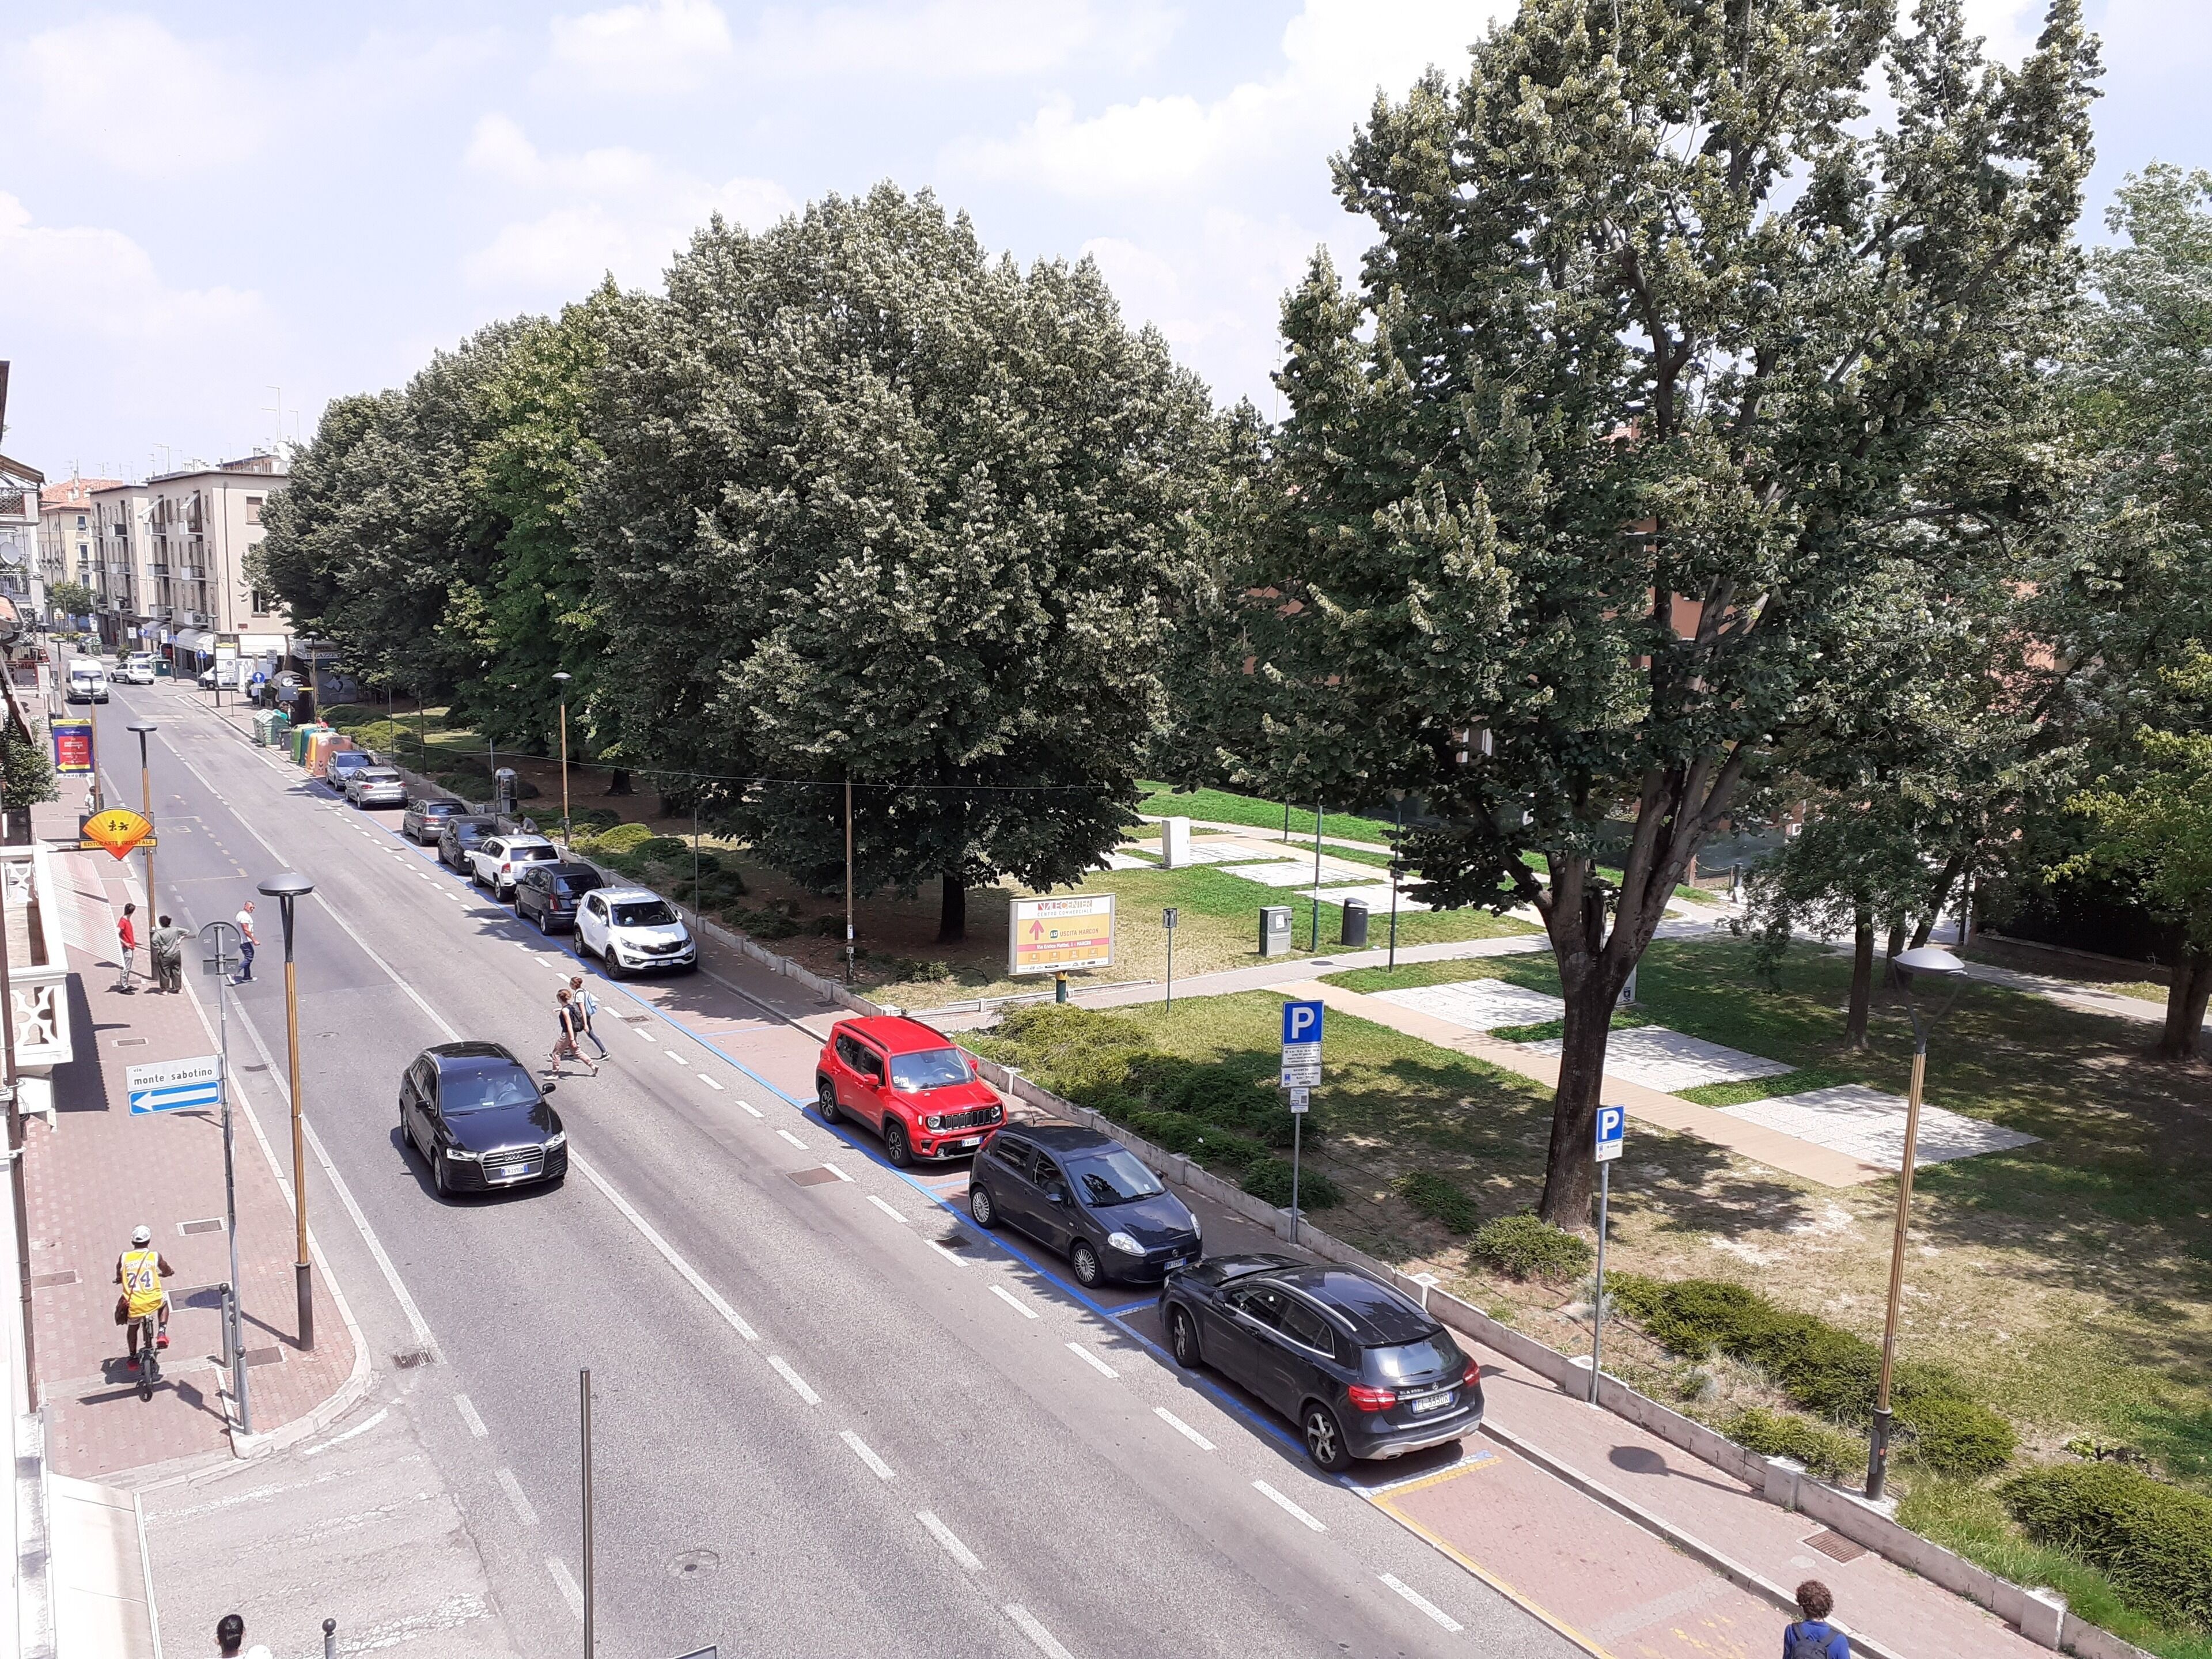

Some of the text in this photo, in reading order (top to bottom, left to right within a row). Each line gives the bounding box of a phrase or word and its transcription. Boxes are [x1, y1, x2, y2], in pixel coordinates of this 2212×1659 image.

[1291, 1007, 1315, 1039] P
[134, 1068, 213, 1085] monte sabotino
[1601, 1110, 1619, 1139] P
[126, 1271, 151, 1289] 24
[1418, 1393, 1448, 1410] FL 333DR
